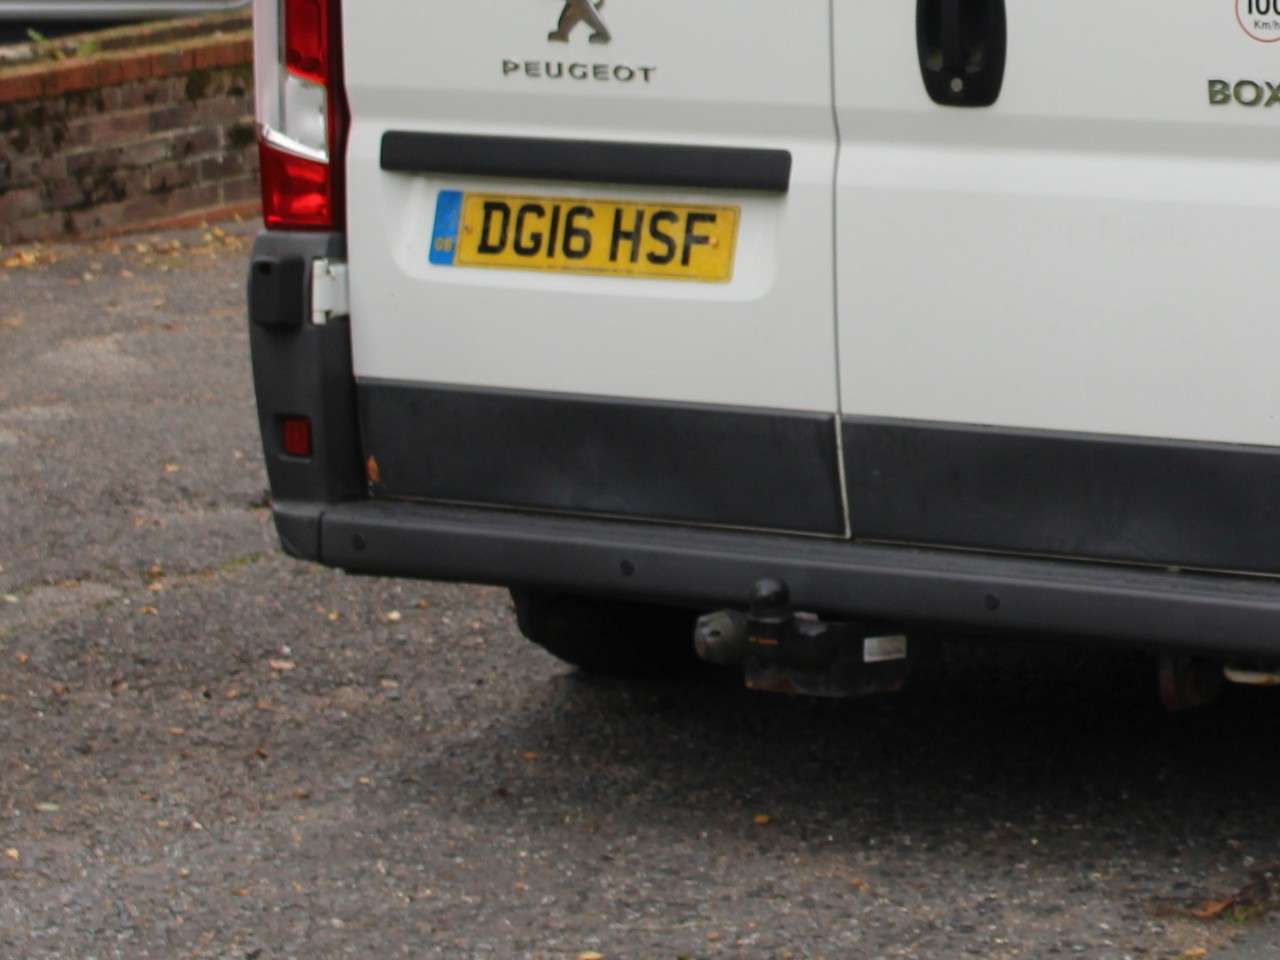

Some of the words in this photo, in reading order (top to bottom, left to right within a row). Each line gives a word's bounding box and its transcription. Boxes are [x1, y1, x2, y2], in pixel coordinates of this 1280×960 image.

[1253, 20, 1280, 31] Km/h
[502, 59, 657, 83] PEUGEOT
[477, 200, 595, 260] DG16
[608, 206, 718, 267] HSF
